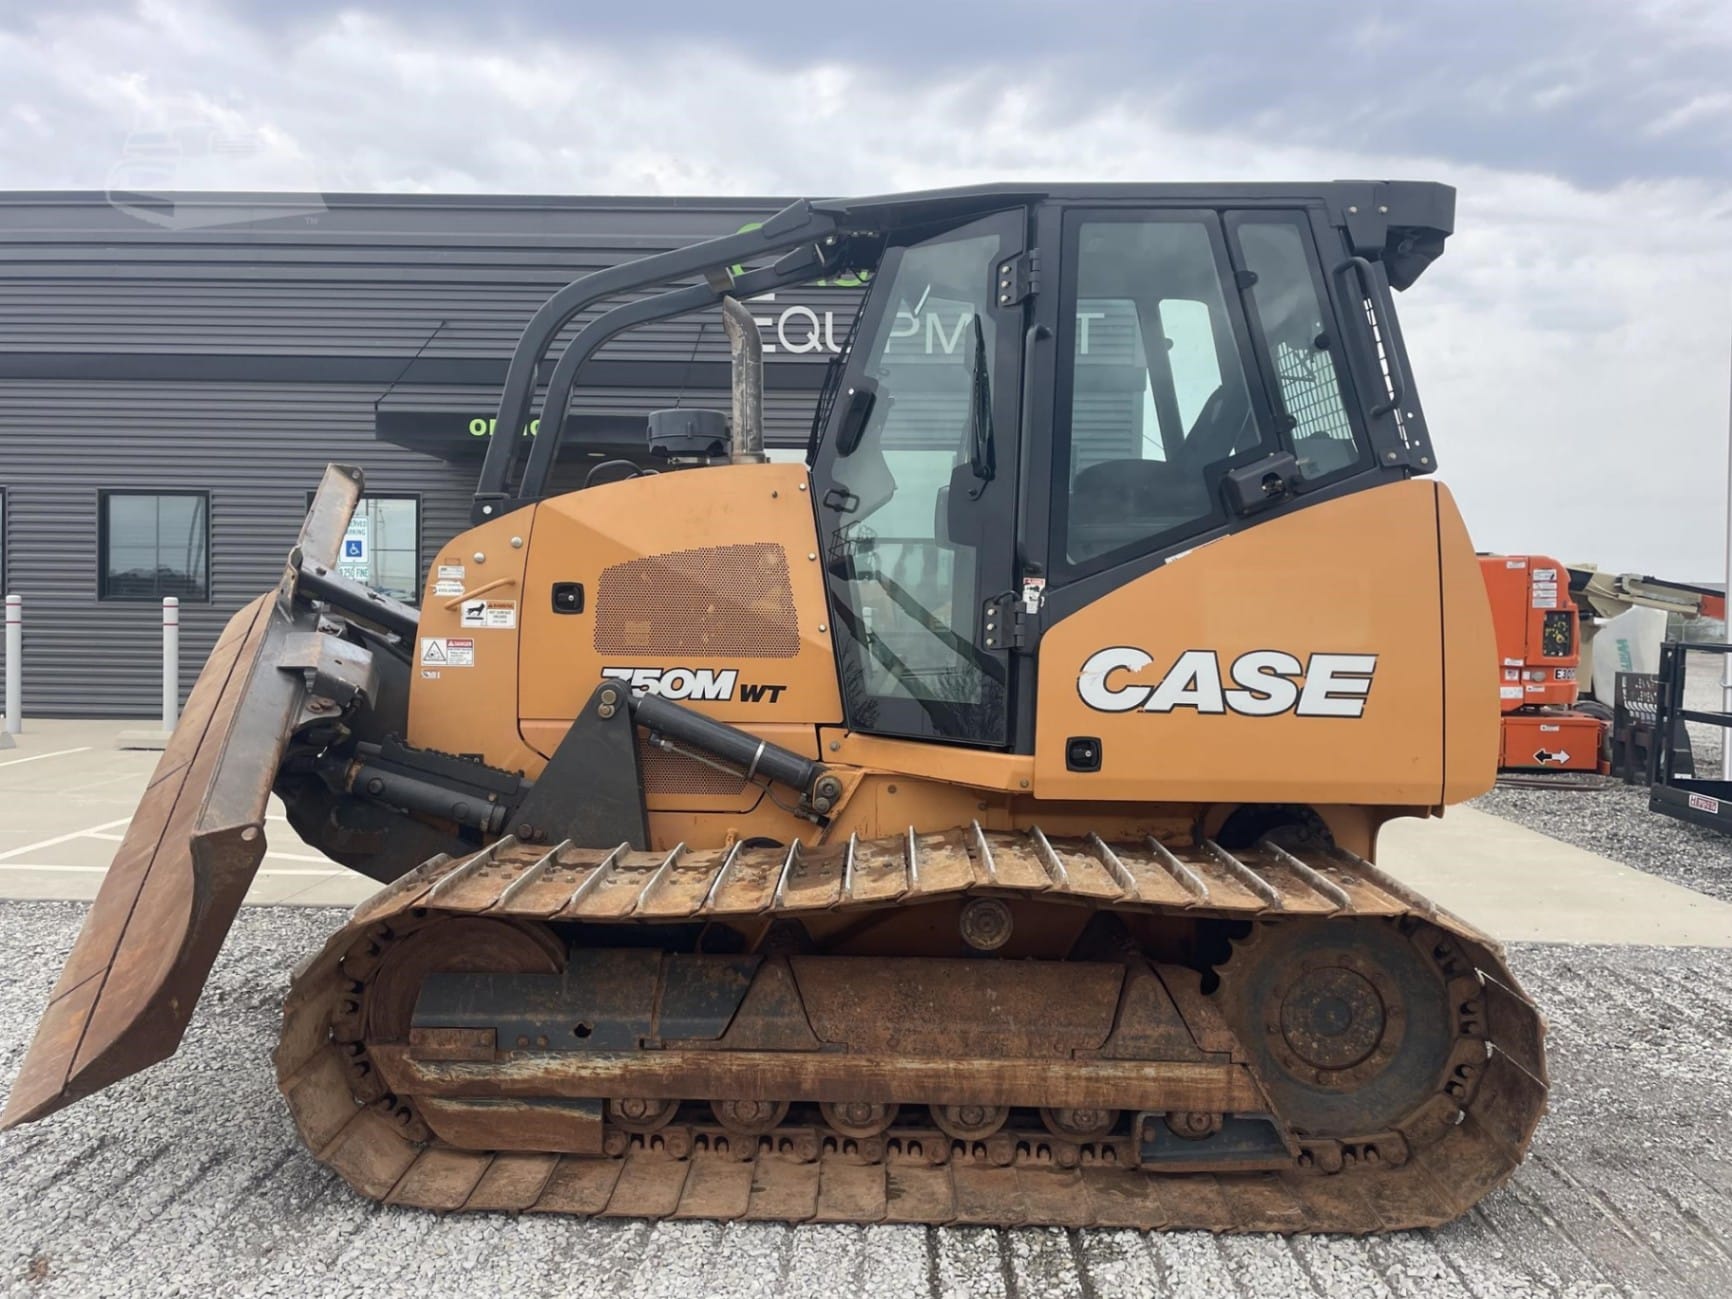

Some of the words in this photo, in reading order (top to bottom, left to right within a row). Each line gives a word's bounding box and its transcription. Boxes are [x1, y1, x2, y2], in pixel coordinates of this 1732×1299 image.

[601, 666, 740, 701] 750M
[740, 684, 787, 704] WT
[1076, 646, 1379, 718] CASE
